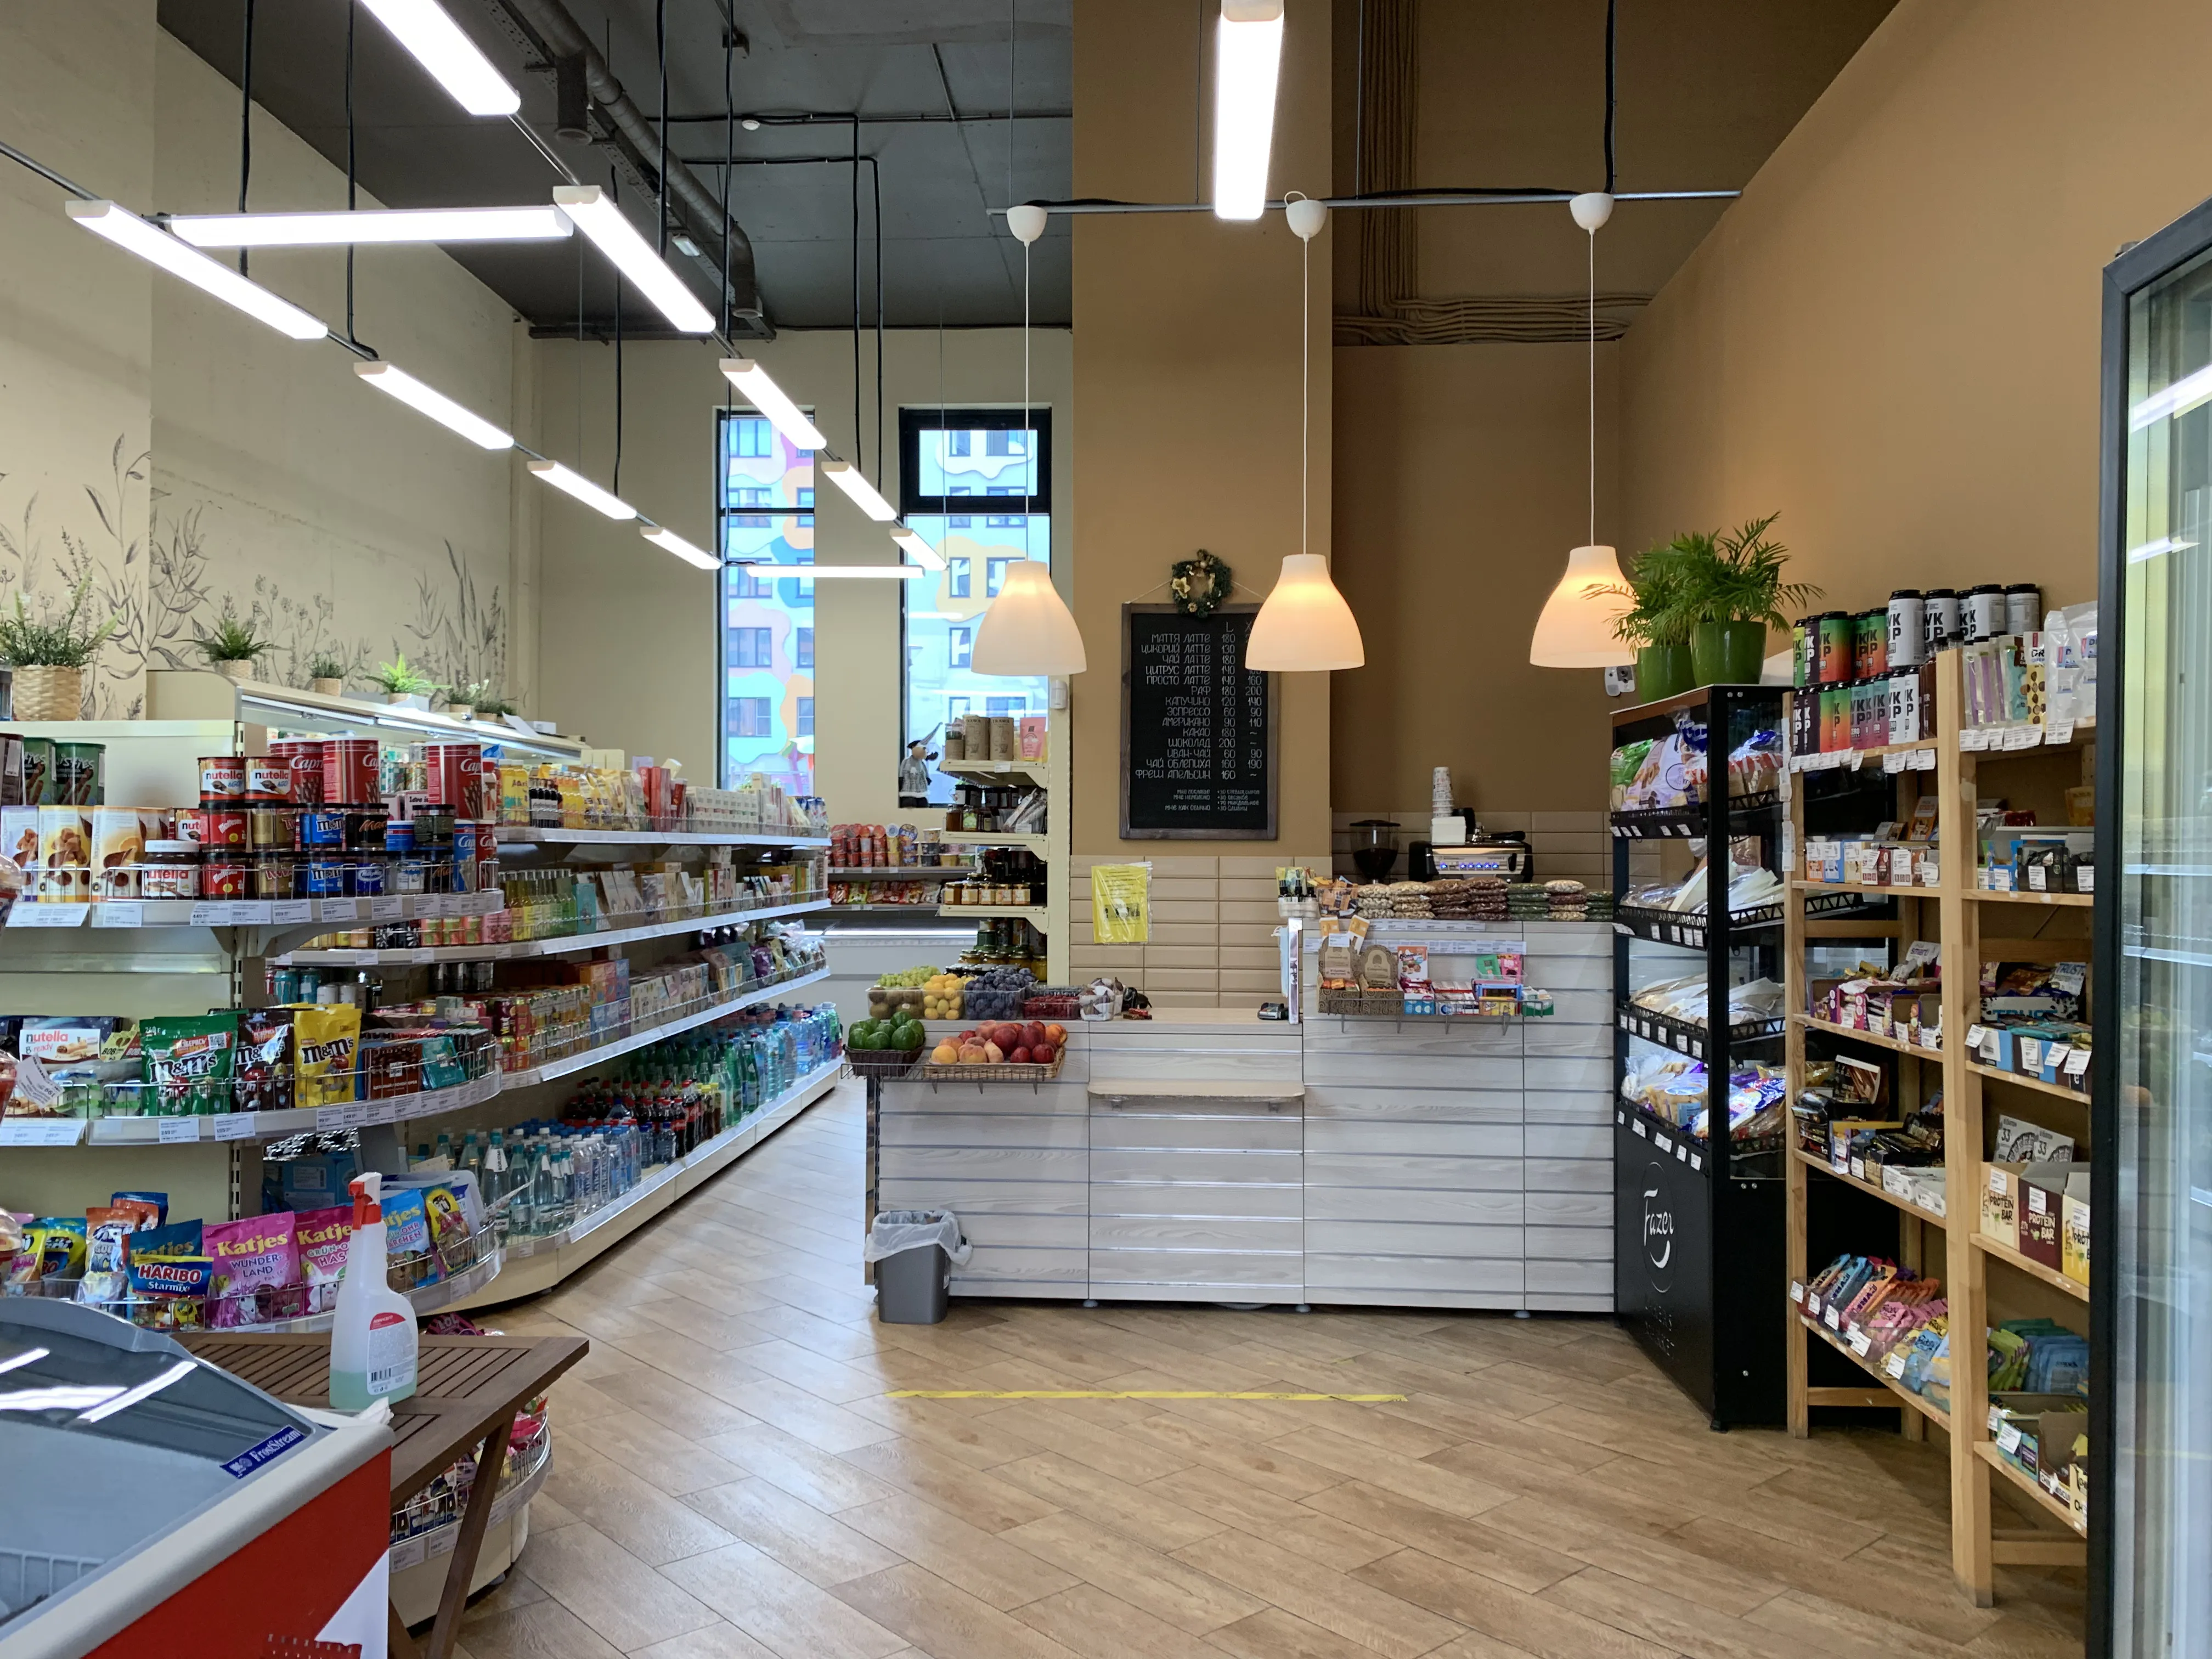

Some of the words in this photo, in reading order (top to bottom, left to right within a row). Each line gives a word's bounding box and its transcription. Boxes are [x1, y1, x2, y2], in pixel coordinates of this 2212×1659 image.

[1226, 622, 1234, 633] L
[1152, 634, 1180, 642] МАТТЯ
[1183, 634, 1210, 642] ЛАТТЕ
[1221, 634, 1235, 642] 180
[1141, 642, 1180, 654] ЦИКОРИЙ
[1183, 644, 1210, 653] ЛАТТЕ
[1221, 644, 1235, 653] 130
[1163, 653, 1180, 664] ЧАЙ
[1183, 654, 1210, 664] ЛАТТЕ
[1222, 654, 1235, 664] 180
[1146, 665, 1180, 675] ЦИТРУС
[1183, 665, 1210, 675] ЛАТТЕ
[1221, 665, 1235, 675] 140
[1147, 675, 1180, 685] ПРОСТО
[1183, 675, 1210, 685] ЛАТТЕ
[1221, 675, 1235, 685] 140
[1248, 675, 1262, 685] 160
[1191, 686, 1211, 696] РАФ
[1221, 686, 1235, 696] 180
[1245, 686, 1262, 696] 200
[1165, 697, 1210, 706] КАПУЧИНО
[1221, 697, 1235, 706] 120
[1248, 697, 1262, 706] 140
[1167, 707, 1210, 716] ЭСПРЕССО
[1223, 707, 1235, 716] 60
[1250, 707, 1262, 716] 90
[1162, 717, 1210, 727] АМЕРИКАНО
[1224, 717, 1235, 727] 90
[1249, 717, 1262, 727] 110
[1183, 728, 1210, 737] КАКАО
[1221, 728, 1235, 737] 180
[1168, 738, 1211, 748] ШОКОЛАД
[1219, 738, 1235, 748] 200
[1167, 749, 1211, 758] ИВАН-ЧАЙ
[1223, 749, 1235, 758] 60
[1250, 749, 1262, 758] 90
[1146, 757, 1164, 769] ЧАЙ
[1167, 759, 1210, 769] ОБЛЕПИХА
[1221, 759, 1235, 769] 160
[1248, 759, 1262, 769] 190
[206, 769, 244, 780] nutella
[255, 770, 289, 780] nutella
[1135, 770, 1164, 780] ФРЕШ
[1167, 770, 1211, 780] АПЕЛЬСИН
[1221, 770, 1235, 780] 160
[182, 821, 200, 830] nut
[144, 870, 188, 879] nutella
[26, 1030, 68, 1042] nutella
[301, 1037, 354, 1064] m&m's
[2001, 1128, 2011, 1142] 33
[2038, 1140, 2047, 1155] 33
[1990, 1195, 2014, 1210] PROTEIN
[1644, 1188, 1674, 1246] Fazer
[2001, 1209, 2013, 1221] BAR
[2029, 1212, 2055, 1228] PROTEIN
[297, 1223, 352, 1245] Katje
[2041, 1226, 2055, 1240] BAR
[2074, 1232, 2090, 1245] PROT
[217, 1233, 289, 1257] Katjes
[307, 1241, 350, 1257] GRÜN-O
[231, 1254, 283, 1269] WUNDER-
[318, 1251, 347, 1267] HAS
[139, 1264, 202, 1284] HARIBO
[242, 1265, 273, 1278] LAND
[148, 1281, 190, 1293] Starmix
[249, 1430, 301, 1463] FrostStream
